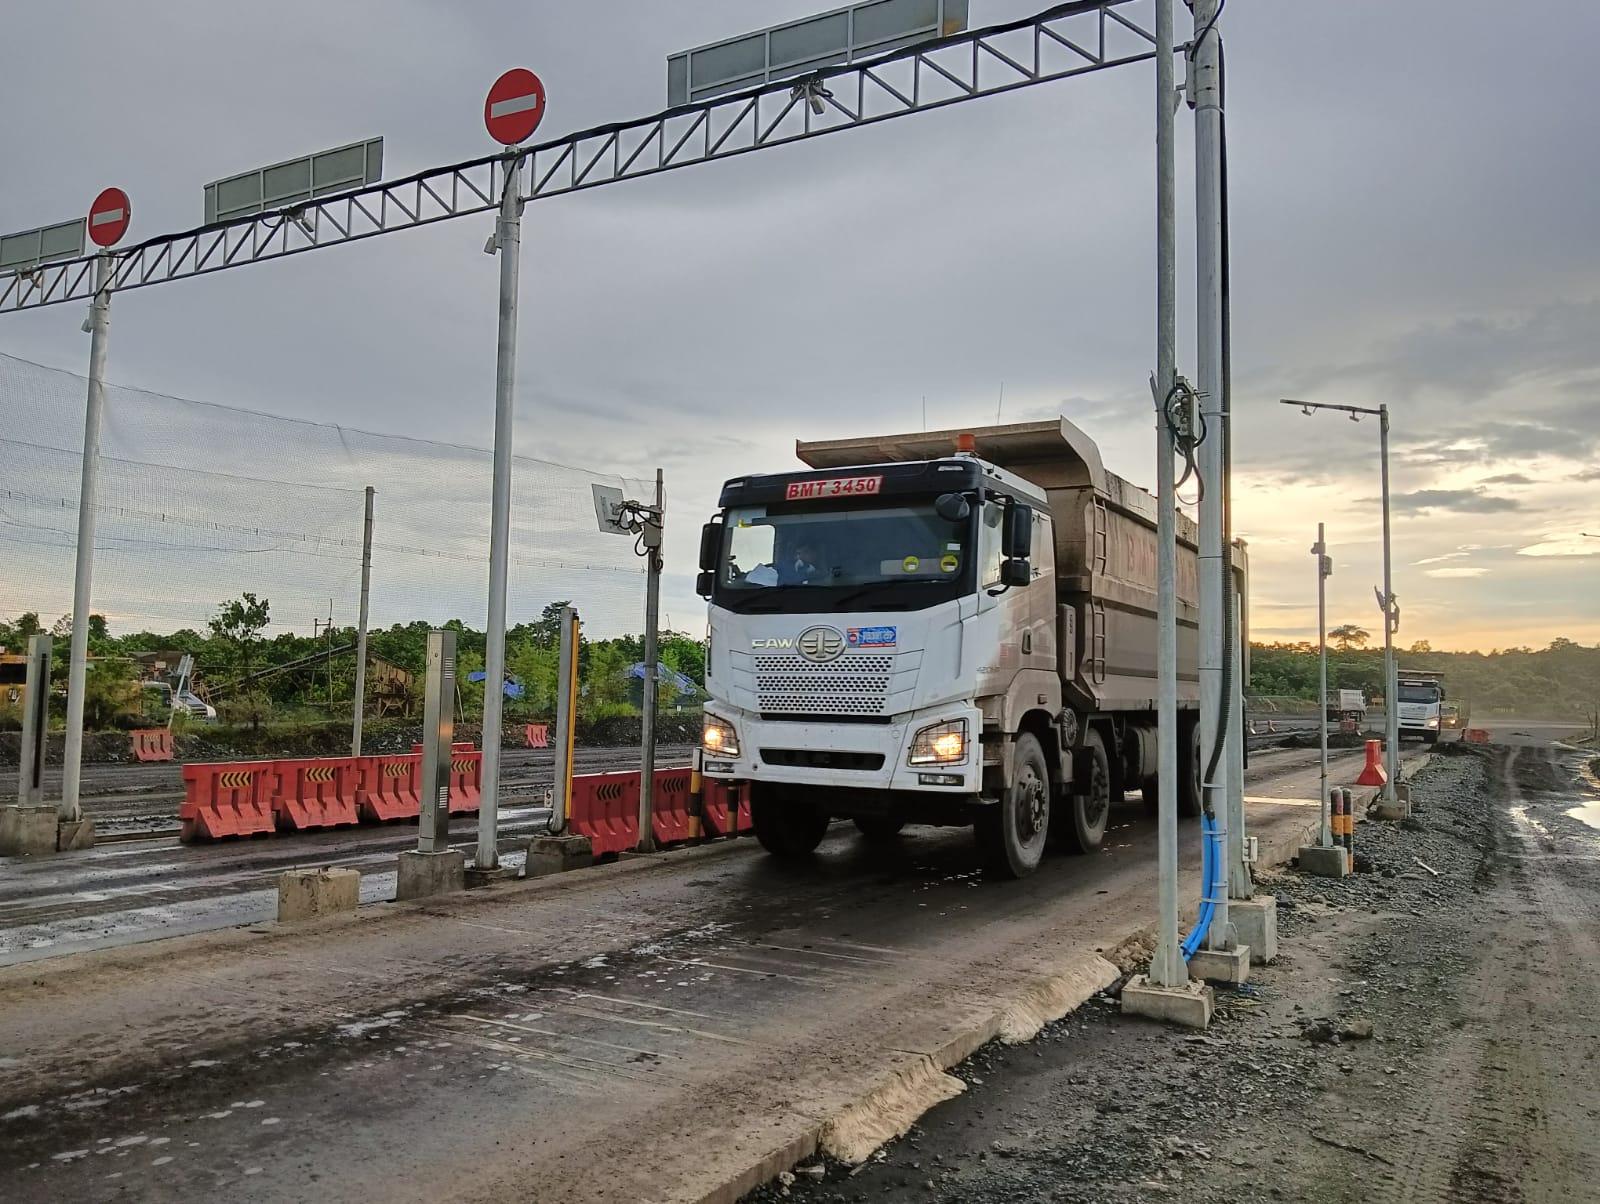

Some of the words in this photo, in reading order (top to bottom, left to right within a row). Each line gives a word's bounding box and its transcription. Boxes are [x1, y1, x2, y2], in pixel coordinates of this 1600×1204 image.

[788, 482, 826, 498] BMT
[831, 478, 876, 495] 3450
[752, 638, 793, 649] FAW
